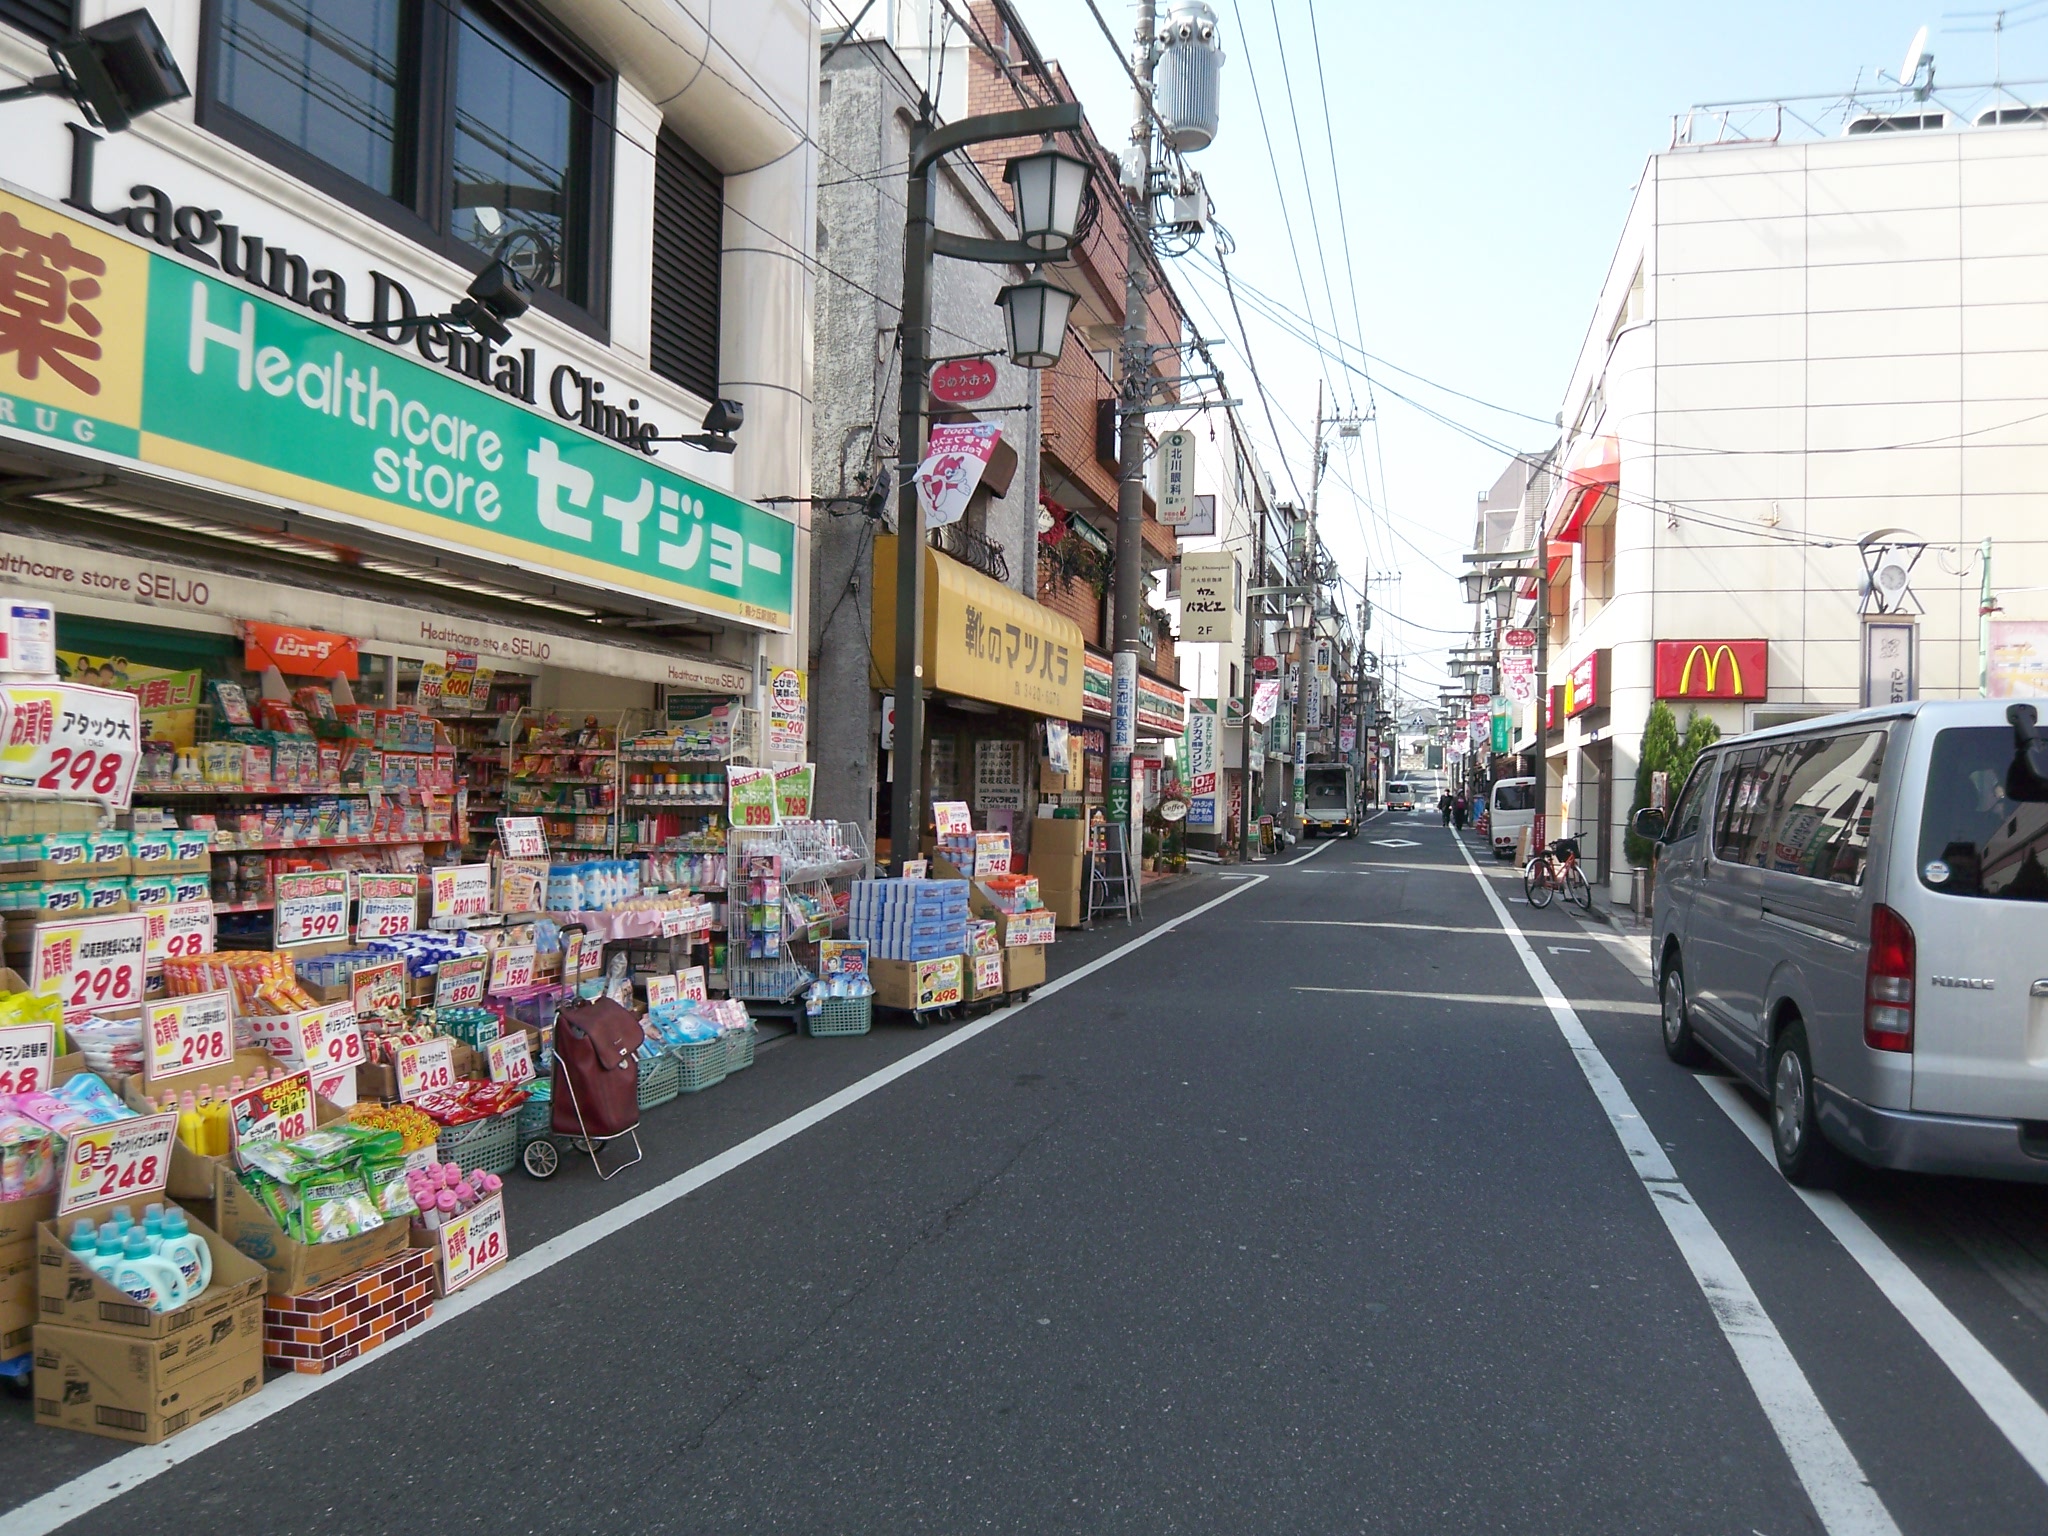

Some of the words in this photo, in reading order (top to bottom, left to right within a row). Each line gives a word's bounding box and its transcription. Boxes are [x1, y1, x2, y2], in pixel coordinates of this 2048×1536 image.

[0, 212, 106, 396] 薬
[63, 123, 348, 323] Laguna
[365, 270, 535, 405] Dental
[549, 364, 659, 456] Clinic
[188, 281, 503, 471] Healthcare
[371, 443, 503, 523] store
[1170, 448, 1182, 495] 北川眼科
[527, 436, 782, 588] セイジョー
[81, 571, 131, 591] store
[137, 572, 209, 605] SEIJO
[420, 621, 480, 647] Healthcare
[483, 638, 508, 653] stoe
[511, 637, 550, 660] SEIJO
[965, 605, 1069, 686] 靴のマツバラ
[1198, 626, 1213, 635] 2F
[275, 636, 332, 659] ムシューダ
[447, 679, 468, 695] 900
[668, 665, 702, 682] Healthcar
[721, 674, 744, 690] SEIJO
[10, 699, 54, 746] お買得
[63, 711, 131, 741] アタック大
[38, 747, 122, 794] 298
[746, 806, 771, 825] 599
[1112, 796, 1128, 814] 文
[1162, 803, 1185, 812] Coffee
[989, 860, 1006, 871] 748
[280, 876, 327, 900] 花粉症
[362, 879, 401, 898] 花粉症
[302, 913, 339, 937] 599
[378, 916, 409, 936] 258
[42, 937, 73, 981] お買得
[167, 933, 203, 957] 98
[71, 965, 132, 1006] 298
[452, 984, 476, 1002] 880
[934, 988, 958, 1003] 498
[1932, 975, 1995, 991] HIACE
[154, 1013, 180, 1046] お買得
[303, 1019, 324, 1049] お買得
[182, 1031, 223, 1065] 298
[328, 1033, 361, 1063] 98
[262, 1080, 297, 1100] 各社共通
[420, 1066, 448, 1091] 248
[278, 1113, 305, 1141] 198
[99, 1155, 158, 1196] 248
[447, 1226, 467, 1261] お買得
[468, 1231, 500, 1271] 148
